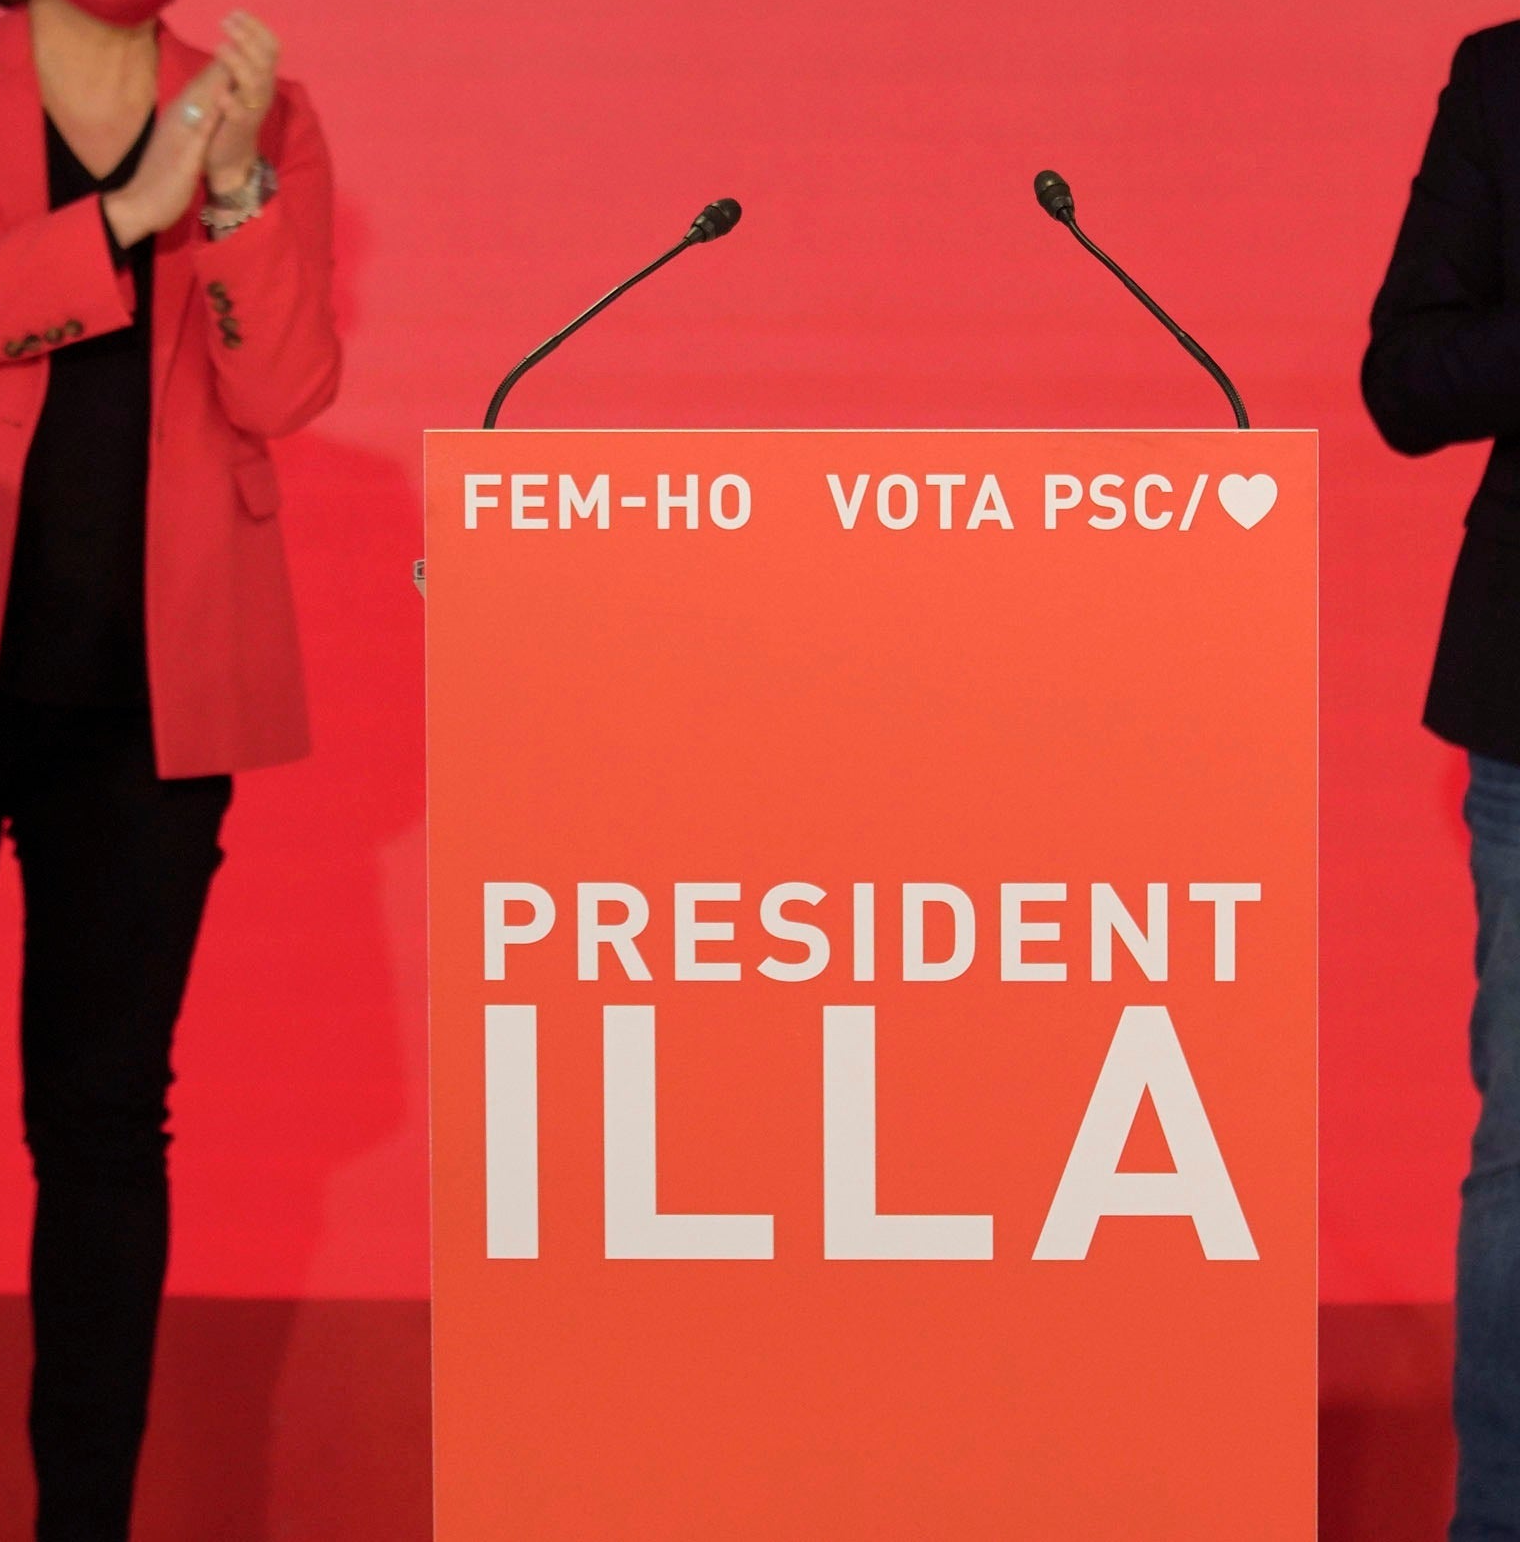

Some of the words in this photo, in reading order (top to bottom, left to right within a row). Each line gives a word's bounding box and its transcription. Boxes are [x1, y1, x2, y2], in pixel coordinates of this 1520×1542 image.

[463, 473, 753, 531] FEM-HO
[825, 473, 1015, 531] VOTA
[1043, 473, 1209, 531] PSC/
[482, 881, 1263, 983] PRESIDENT
[483, 1003, 1261, 1262] ILLA
